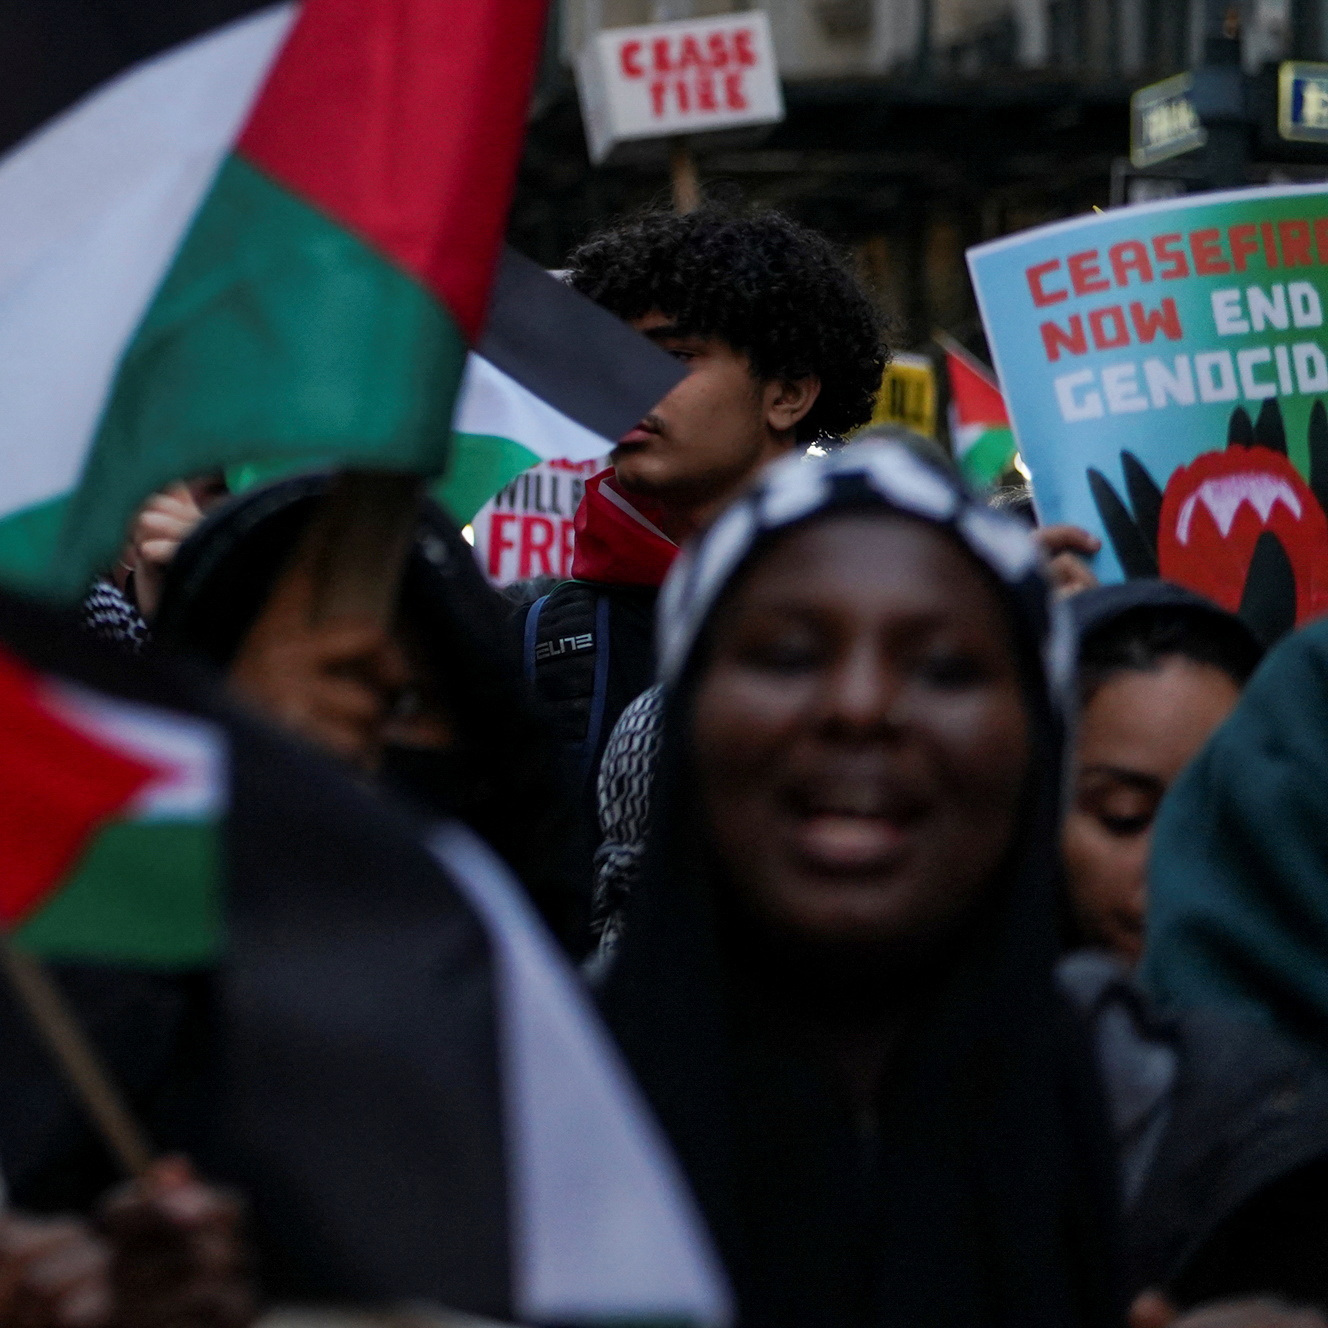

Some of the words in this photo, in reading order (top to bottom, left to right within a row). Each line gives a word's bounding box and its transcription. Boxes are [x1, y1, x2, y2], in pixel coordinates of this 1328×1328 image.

[620, 29, 758, 80] CEASE
[1039, 297, 1183, 364] NOW
[1210, 281, 1323, 337] END
[1053, 341, 1328, 423] GENOCID
